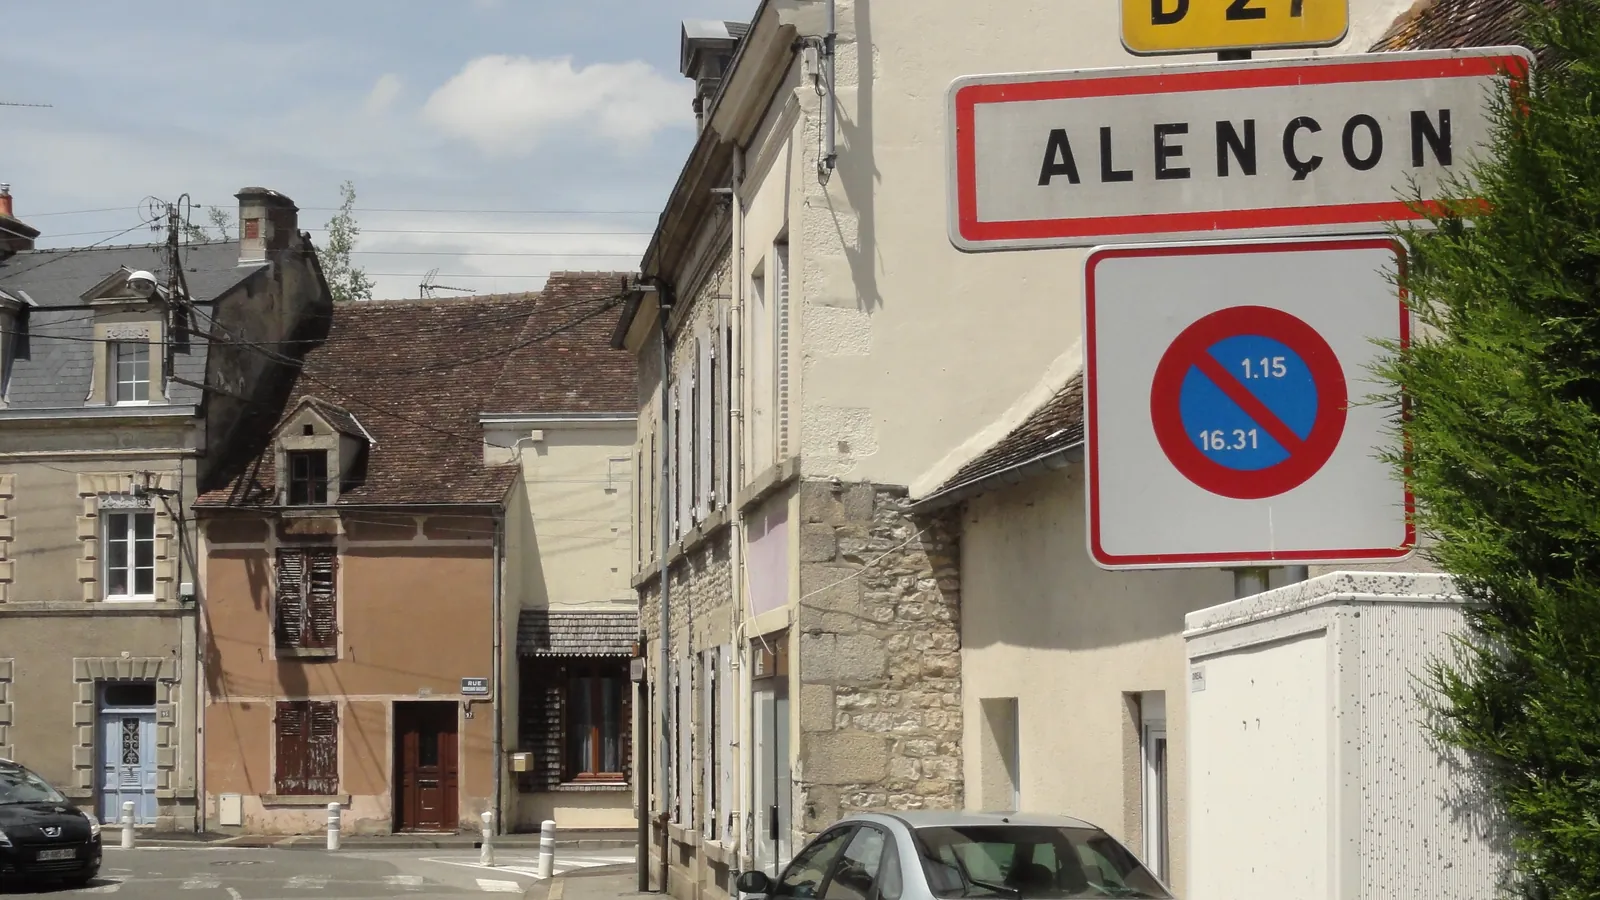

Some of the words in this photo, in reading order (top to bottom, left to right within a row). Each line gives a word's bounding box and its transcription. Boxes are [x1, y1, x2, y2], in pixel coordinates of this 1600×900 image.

[1037, 108, 1453, 187] ALENÇON
[1241, 356, 1288, 379] 1.15
[1199, 428, 1258, 451] 16.31
